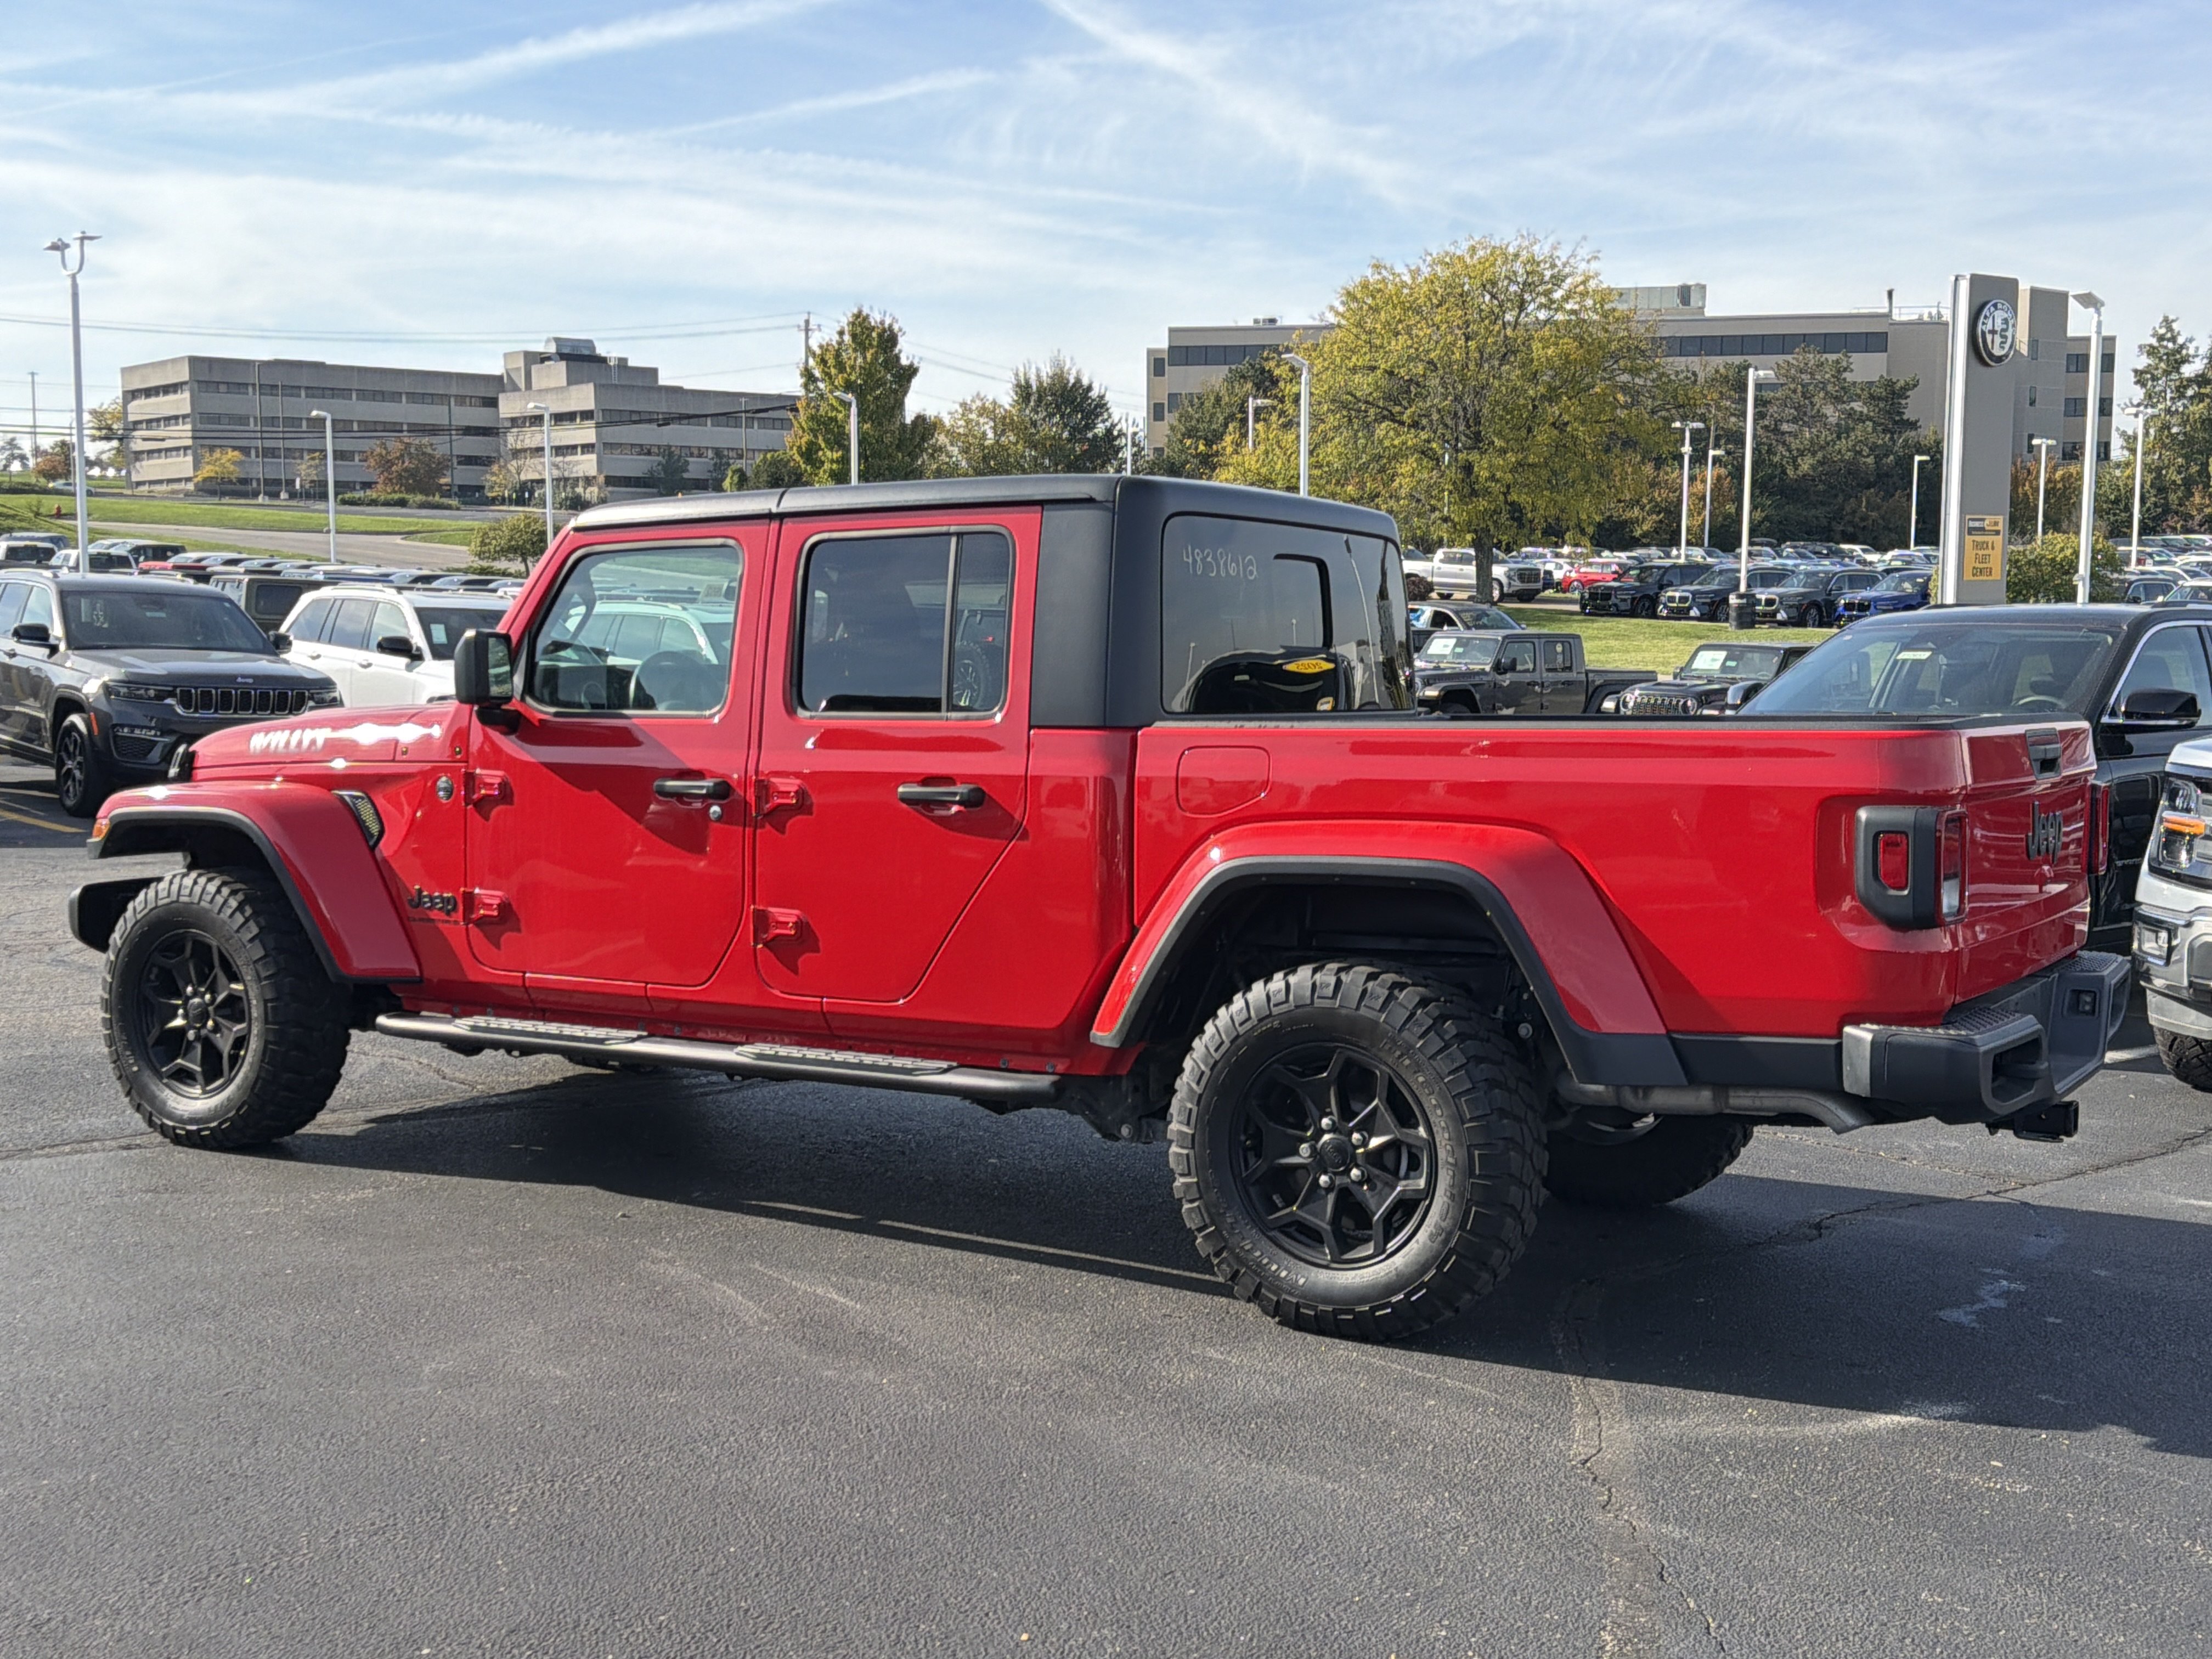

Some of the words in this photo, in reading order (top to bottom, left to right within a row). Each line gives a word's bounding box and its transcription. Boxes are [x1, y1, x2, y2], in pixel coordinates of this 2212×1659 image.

[1981, 306, 1995, 332] ALFA
[1972, 539, 1989, 551] TRUCK
[1183, 544, 1259, 580] 4838612
[1975, 553, 1991, 564] FLEET
[1972, 566, 1993, 578] CENTER
[2027, 801, 2063, 865] Jeep
[408, 884, 458, 915] Jeep
